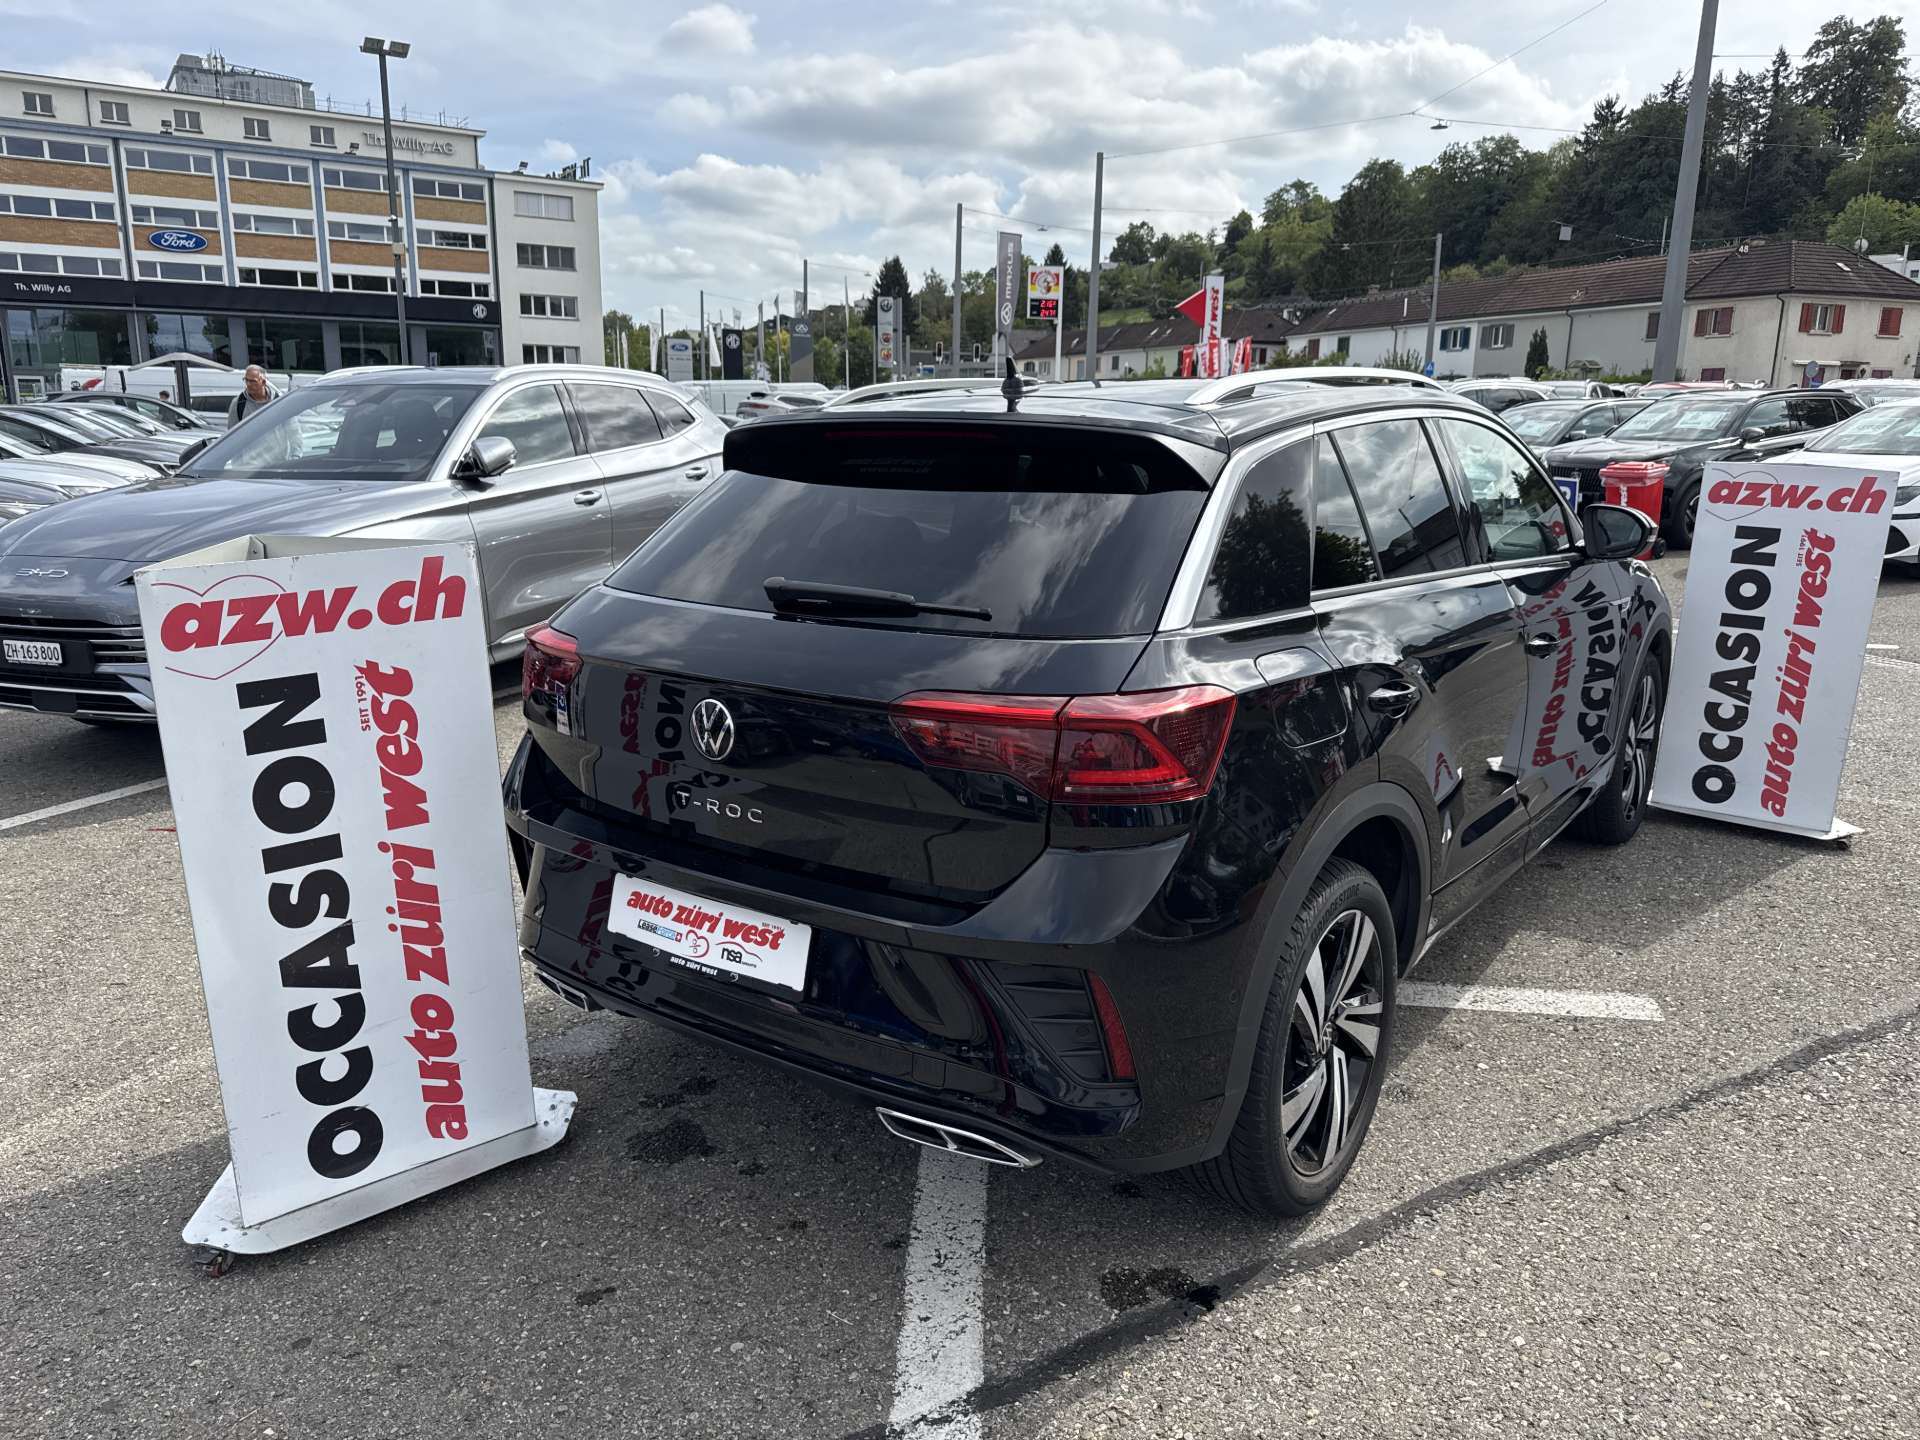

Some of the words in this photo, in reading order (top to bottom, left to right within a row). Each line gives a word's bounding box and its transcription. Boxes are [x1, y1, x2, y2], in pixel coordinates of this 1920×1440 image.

[392, 135, 429, 154] Willy
[432, 140, 455, 155] AG
[160, 231, 197, 248] Ford
[14, 282, 29, 291] Th.
[31, 283, 55, 294] Willy
[57, 284, 72, 293] AG
[1707, 476, 1888, 514] azw.ch
[15, 568, 69, 578] BYD
[1793, 528, 1835, 627] west
[160, 555, 467, 652] azw.ch
[355, 675, 367, 703] 1991
[1691, 525, 1782, 804] OCCASION
[1775, 628, 1817, 725] züri
[359, 707, 371, 732] SEIT
[353, 659, 431, 831] west
[1760, 722, 1798, 818] auto
[676, 790, 763, 823] T-ROC
[235, 672, 384, 1179] OCCASION
[377, 840, 450, 986] züri
[626, 890, 673, 918] auto
[671, 905, 723, 933] züri
[722, 918, 786, 950] west
[670, 956, 685, 966] auto
[701, 965, 718, 976] west
[721, 947, 743, 964] nsa
[403, 993, 469, 1141] auto
